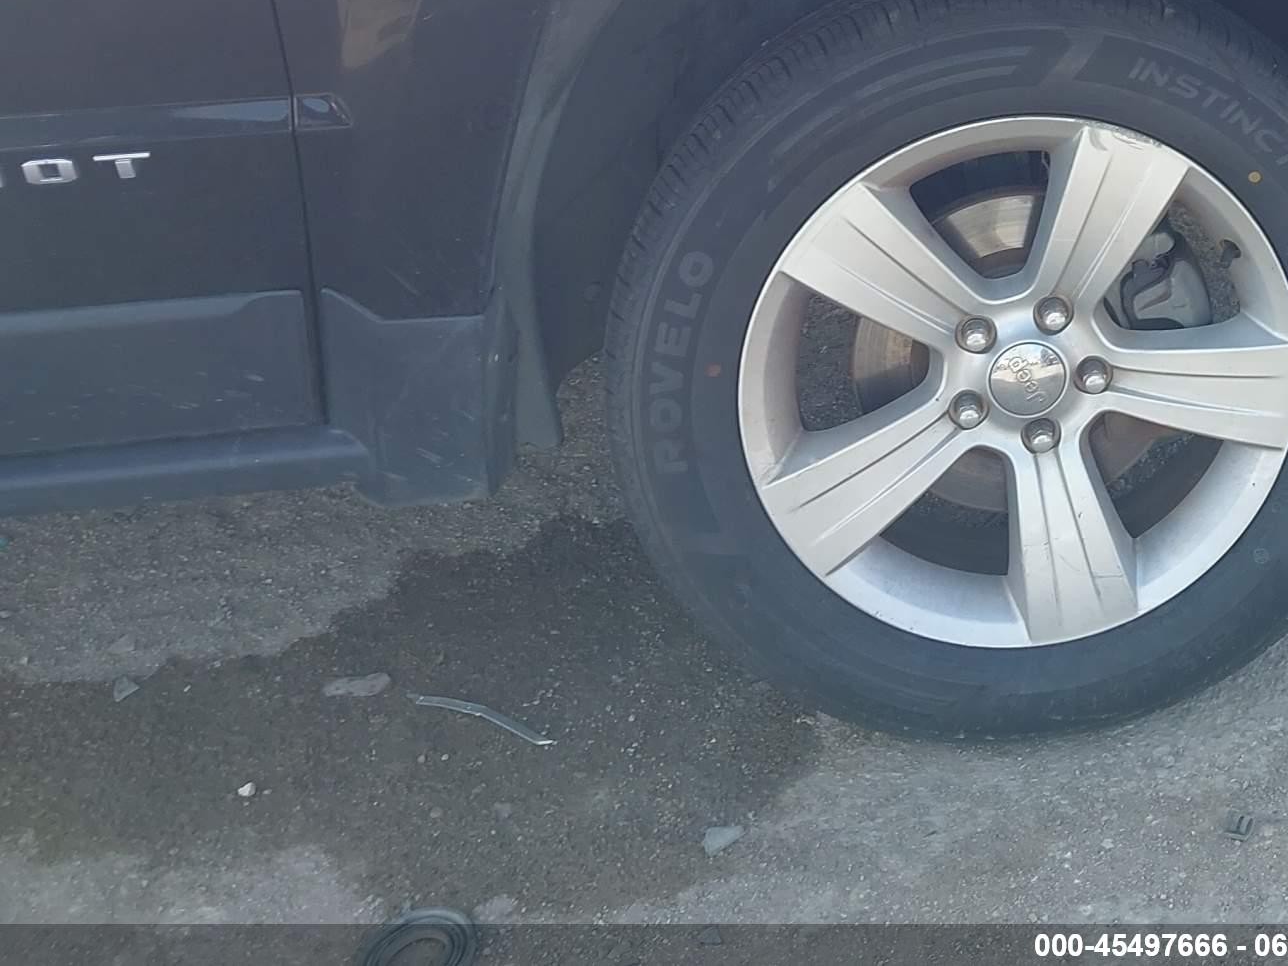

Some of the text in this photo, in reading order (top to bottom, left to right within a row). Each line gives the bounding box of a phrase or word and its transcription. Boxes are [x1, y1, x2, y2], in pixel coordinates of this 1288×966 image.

[0, 151, 151, 187] OT
[650, 250, 714, 475] ROVELO
[1008, 356, 1047, 403] Jeep
